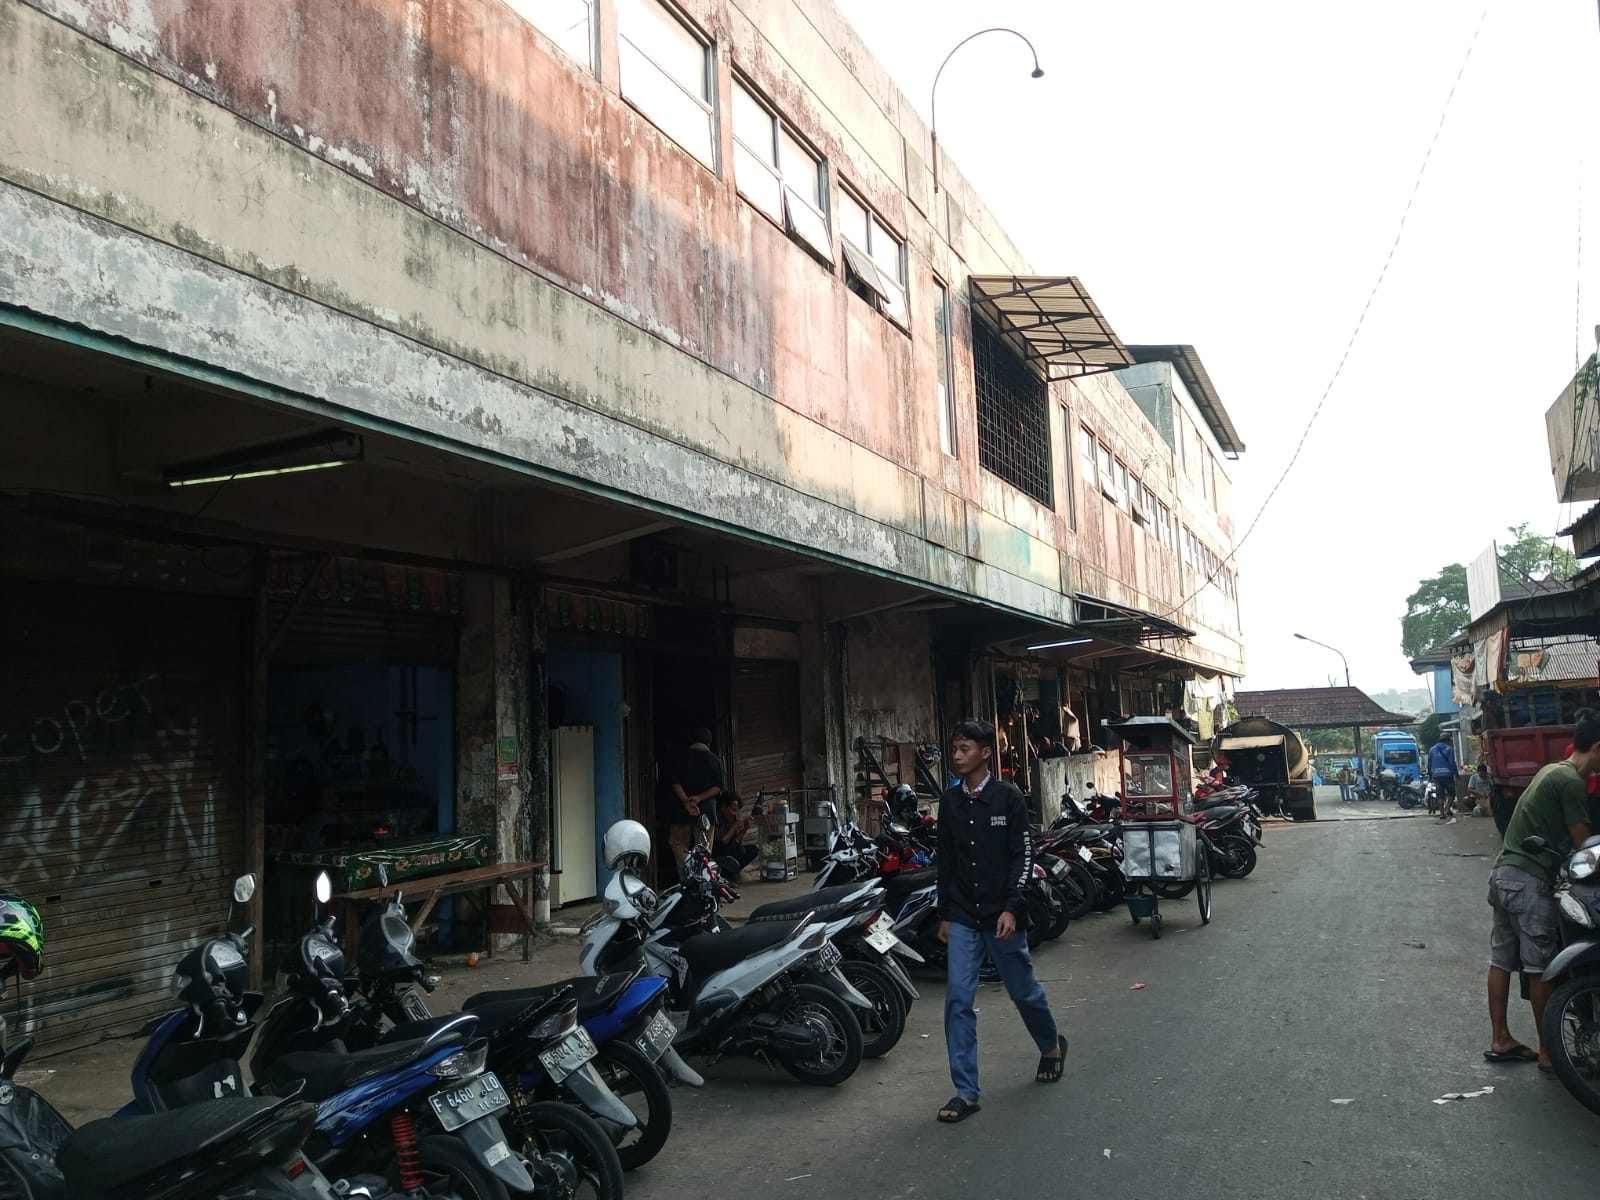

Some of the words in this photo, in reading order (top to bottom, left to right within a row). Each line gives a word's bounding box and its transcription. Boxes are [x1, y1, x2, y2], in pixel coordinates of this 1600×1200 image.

[637, 1037, 647, 1052] F
[432, 1098, 443, 1113] F
[445, 1086, 474, 1107] 6460
